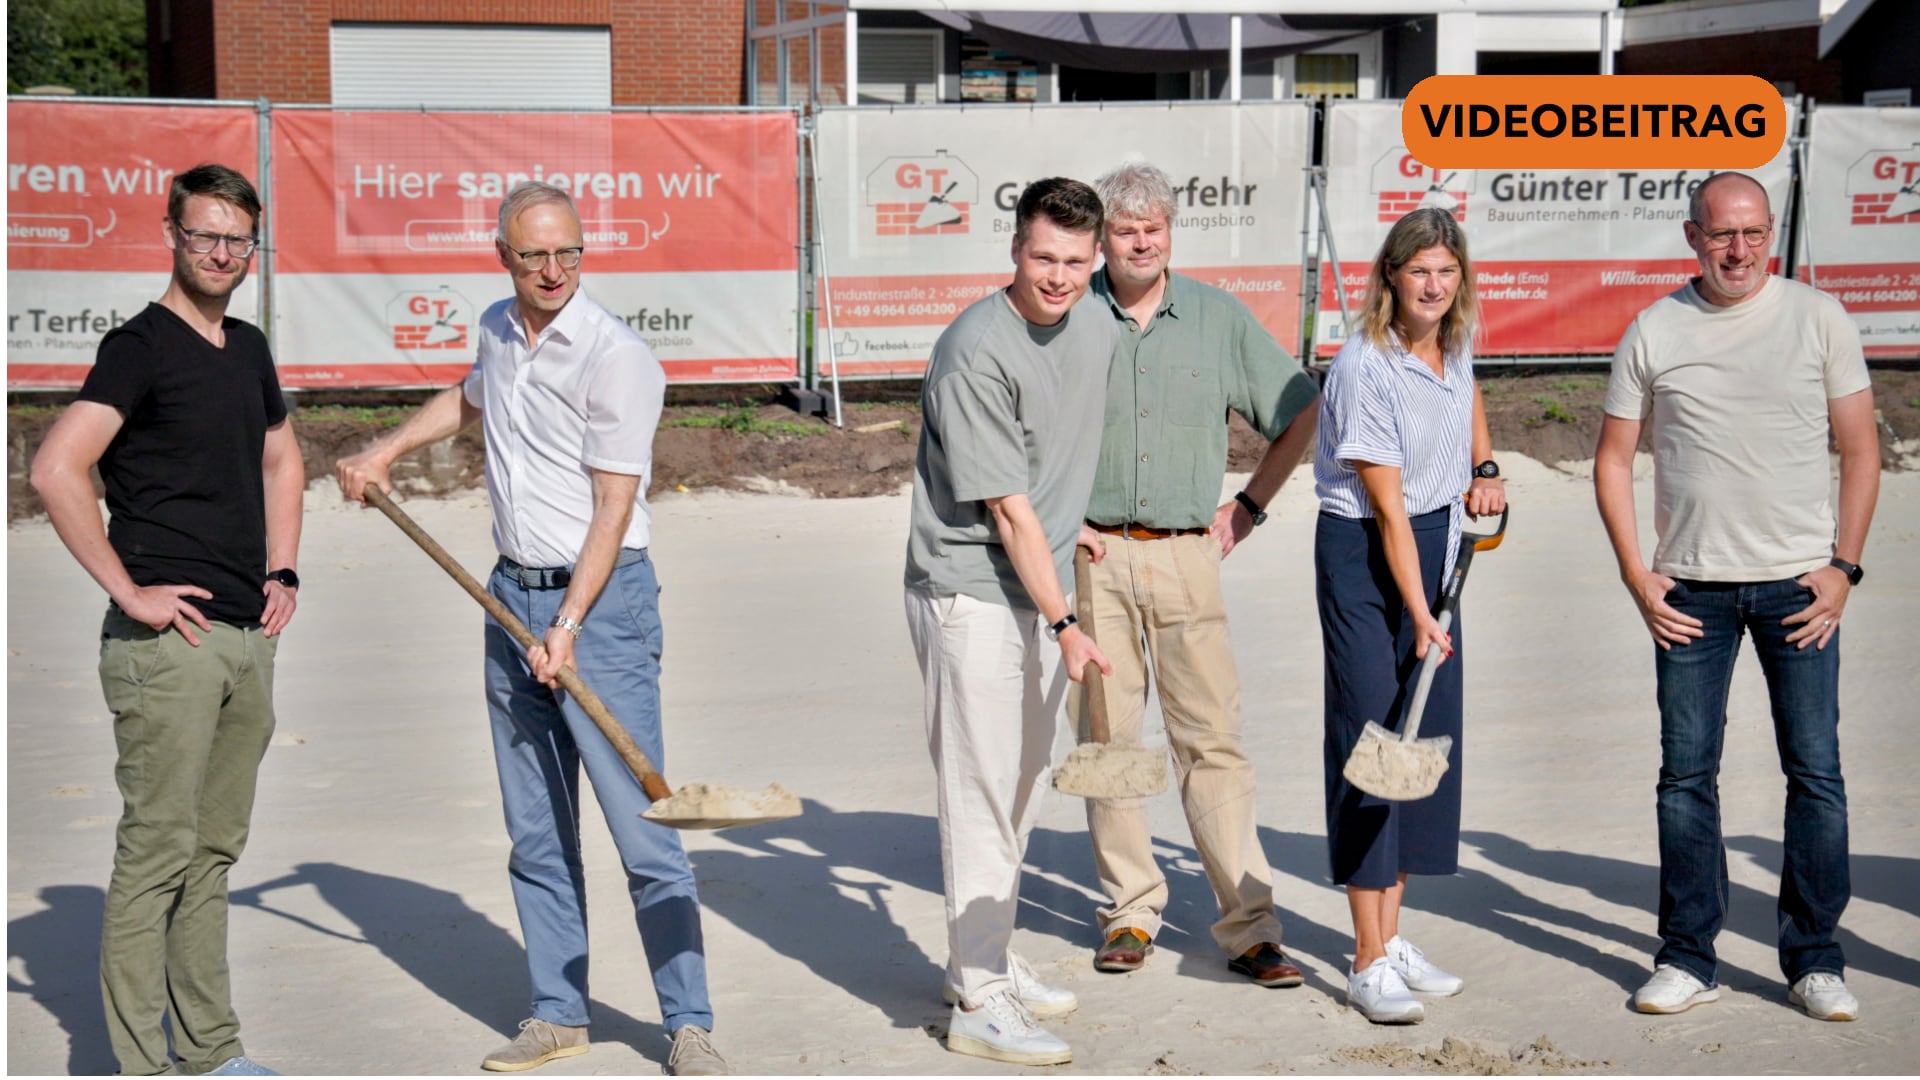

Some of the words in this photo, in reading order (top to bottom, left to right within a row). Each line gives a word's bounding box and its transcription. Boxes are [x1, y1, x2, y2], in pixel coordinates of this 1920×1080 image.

[102, 159, 174, 195] wir
[354, 164, 443, 199] Hier
[657, 164, 722, 198] wir
[896, 163, 949, 194] GT
[1171, 175, 1258, 208] rfehr
[1490, 172, 1608, 202] Günter
[1617, 170, 1715, 200] Terfe
[1488, 206, 1620, 222] Bauunternehmen
[1632, 205, 1692, 221] Planun
[1476, 272, 1516, 285] Rhede
[1518, 271, 1549, 286] (Ems)
[408, 295, 450, 319] GT
[616, 307, 694, 332] rfehr
